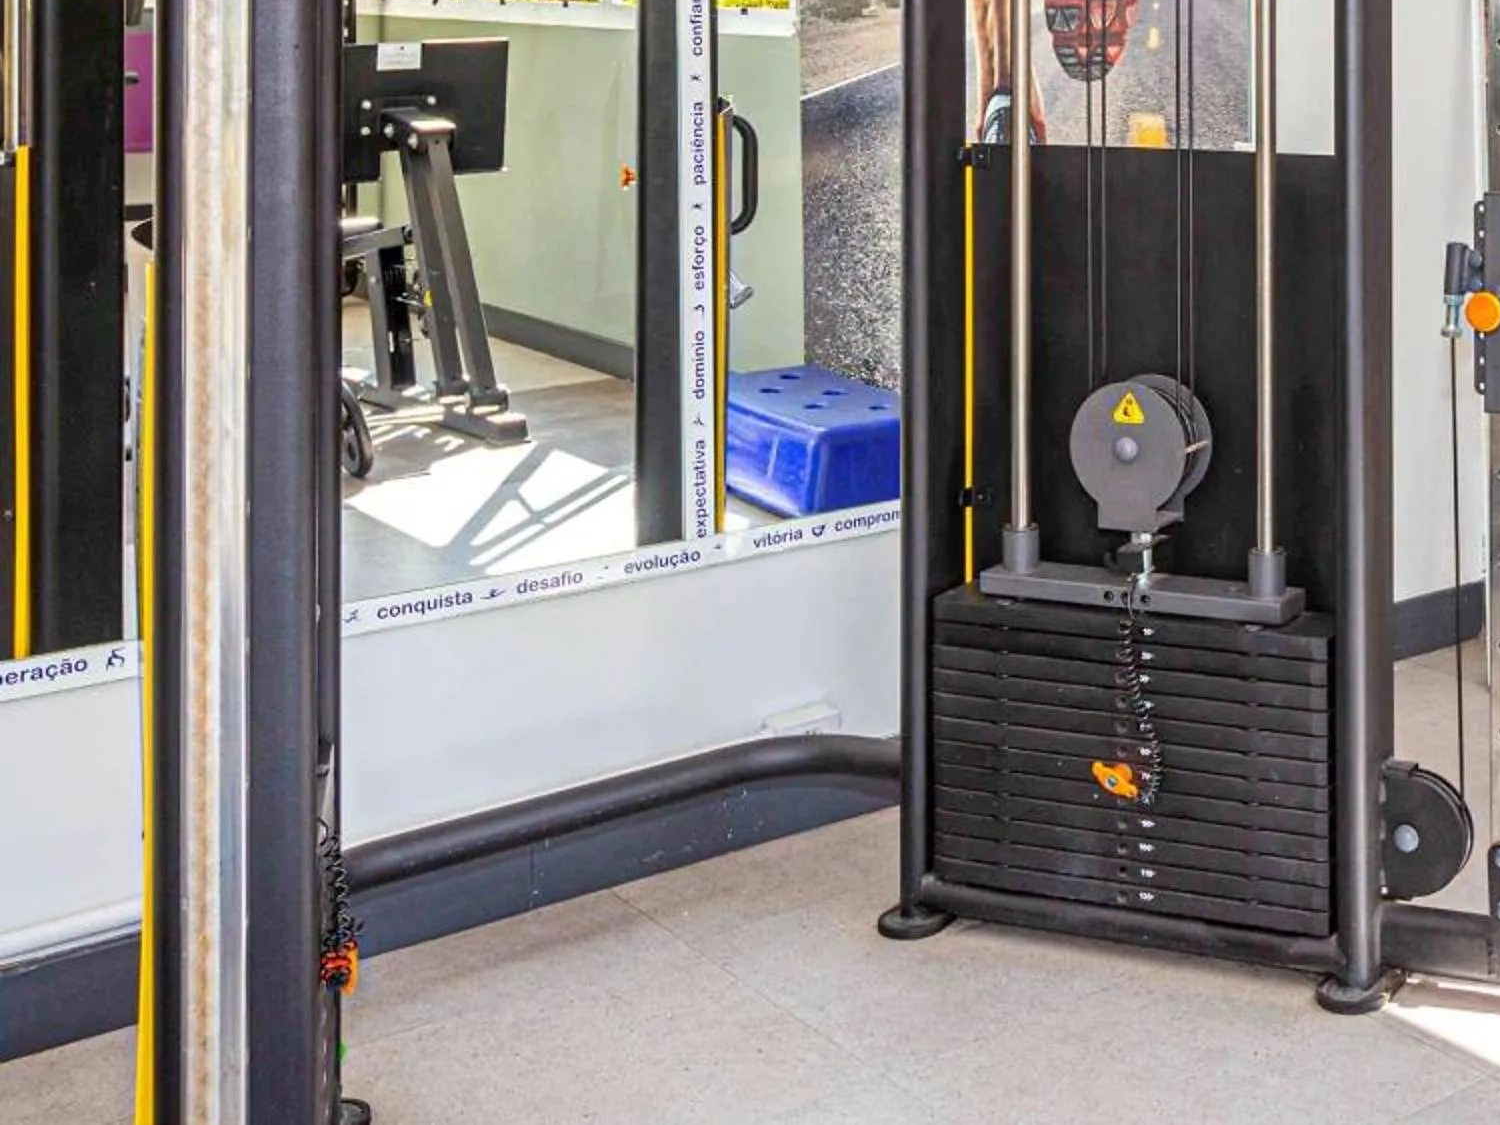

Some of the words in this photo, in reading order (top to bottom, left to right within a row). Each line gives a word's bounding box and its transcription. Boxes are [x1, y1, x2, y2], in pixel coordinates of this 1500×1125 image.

[690, 101, 708, 186] paciência
[691, 225, 708, 291] esforço
[692, 439, 707, 539] expectativa
[0, 658, 88, 687] eração
[376, 589, 474, 623] conquista
[516, 570, 584, 596] desafio
[623, 549, 702, 575] evolução
[753, 528, 804, 550] vitória
